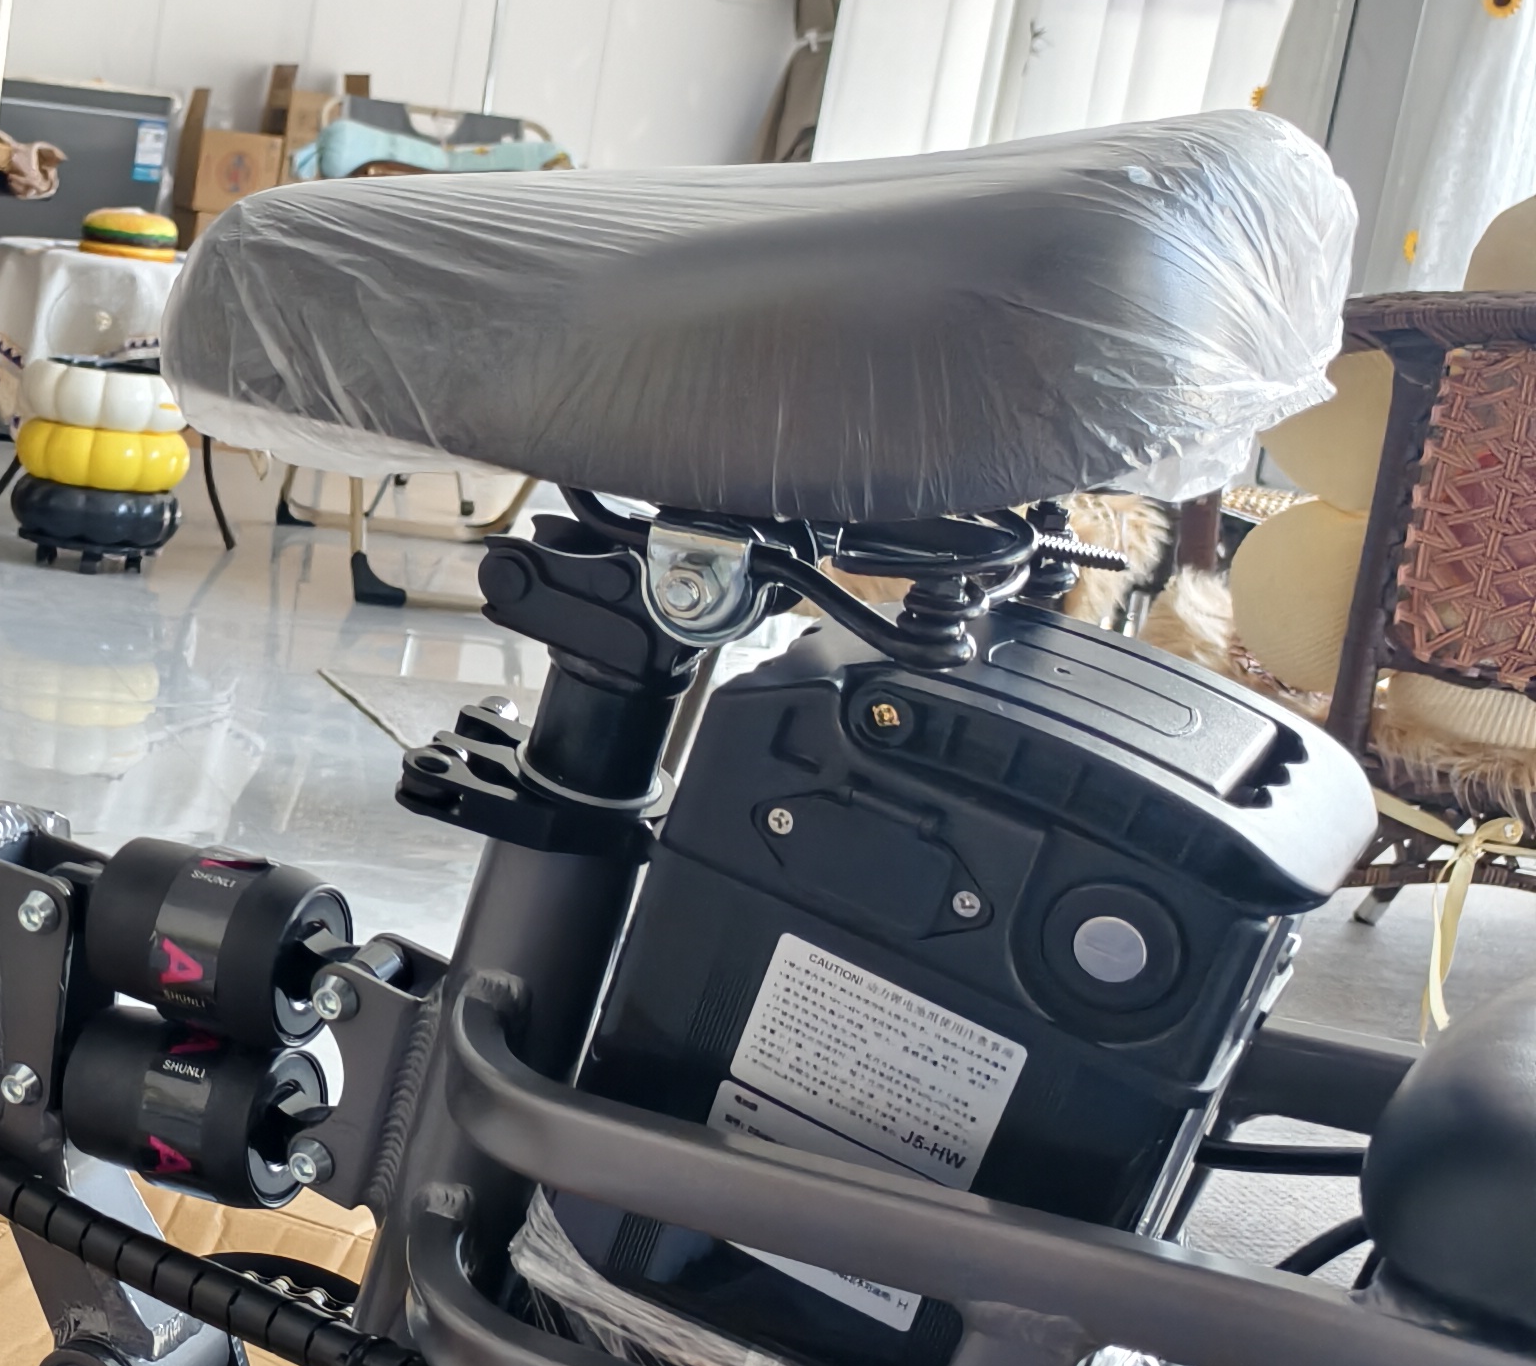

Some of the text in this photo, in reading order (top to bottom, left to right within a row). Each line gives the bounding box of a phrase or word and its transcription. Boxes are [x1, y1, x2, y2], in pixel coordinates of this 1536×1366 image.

[191, 870, 237, 888] SHUNLI
[809, 953, 864, 986] CAUTION!
[163, 1059, 206, 1079] SHUNLI
